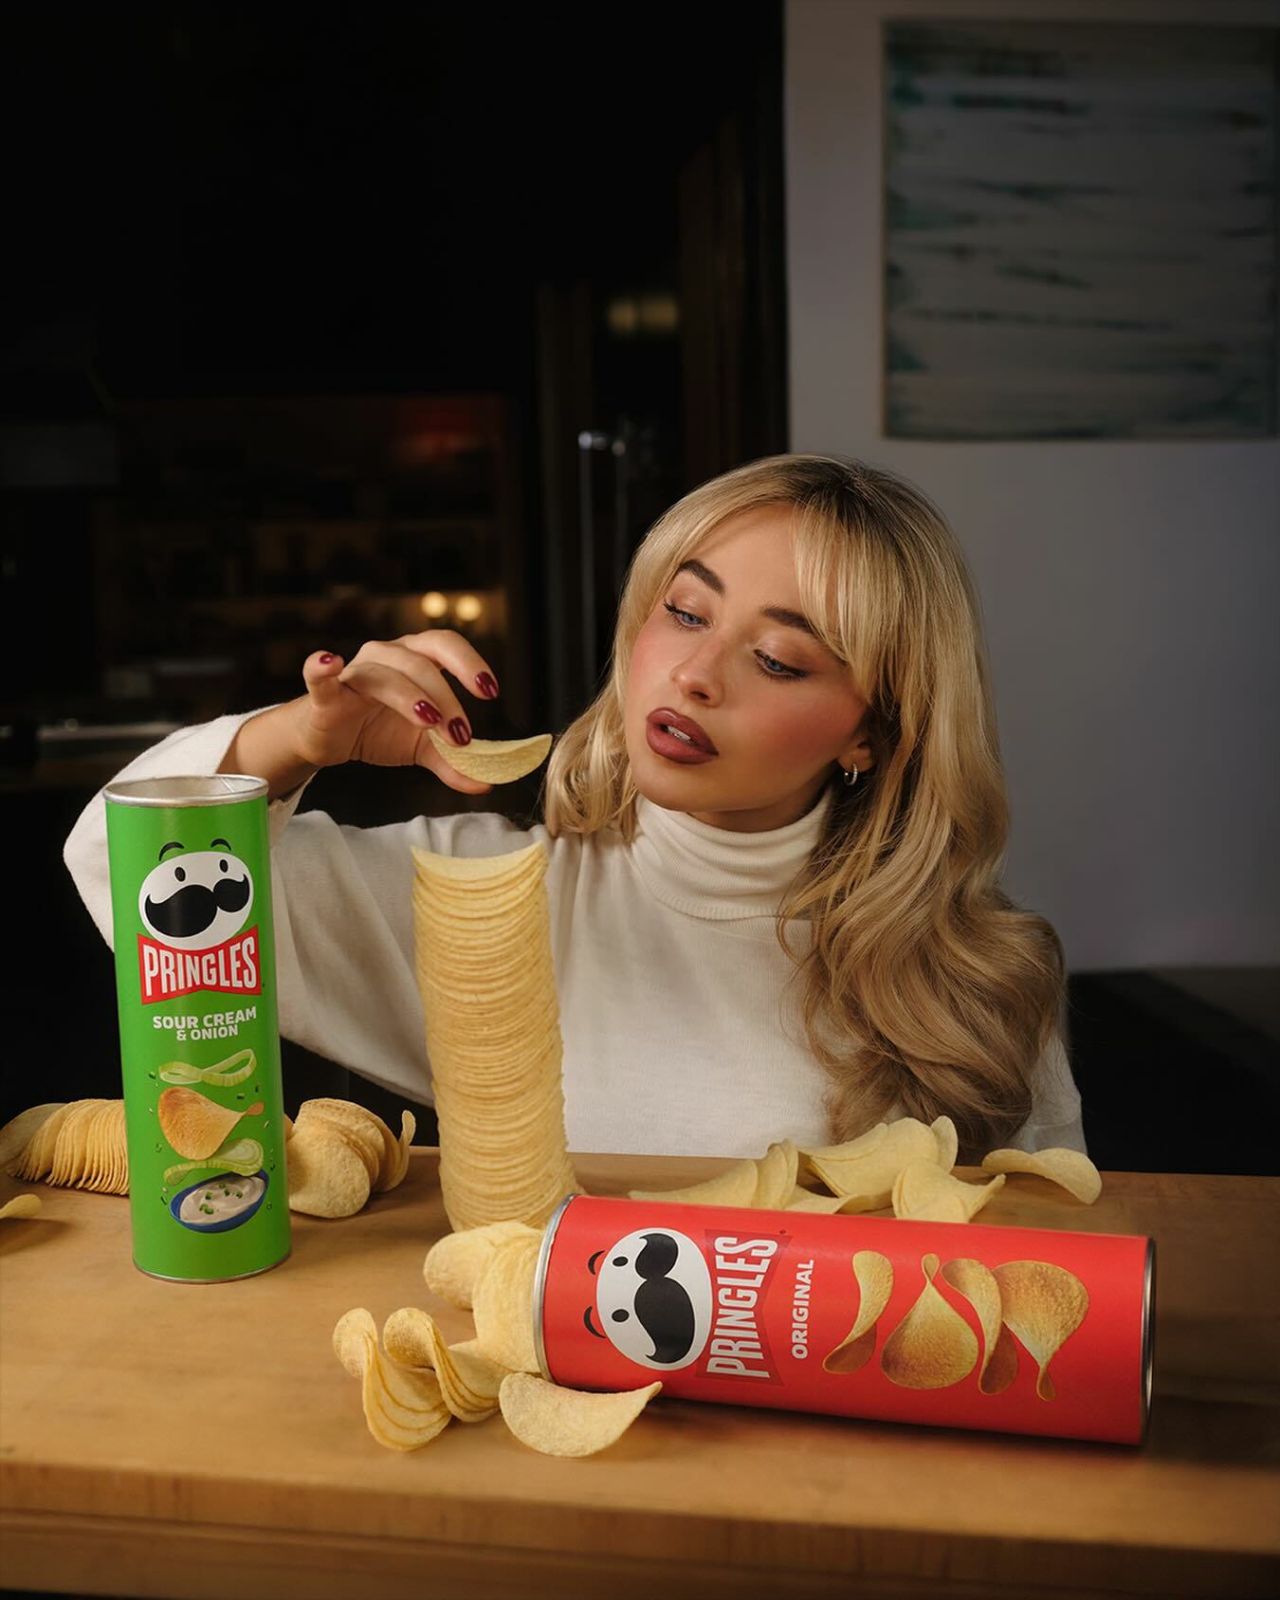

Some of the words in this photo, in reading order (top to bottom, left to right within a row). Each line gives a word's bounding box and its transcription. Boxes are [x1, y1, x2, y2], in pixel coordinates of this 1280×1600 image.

[143, 936, 257, 997] PRINGLES
[152, 1015, 199, 1029] SOUR
[203, 1006, 257, 1028] CREAM
[176, 1029, 187, 1041] &
[190, 1024, 239, 1041] ONION
[706, 1236, 778, 1378] PRINGLES
[791, 1259, 814, 1359] ORIGINAL
